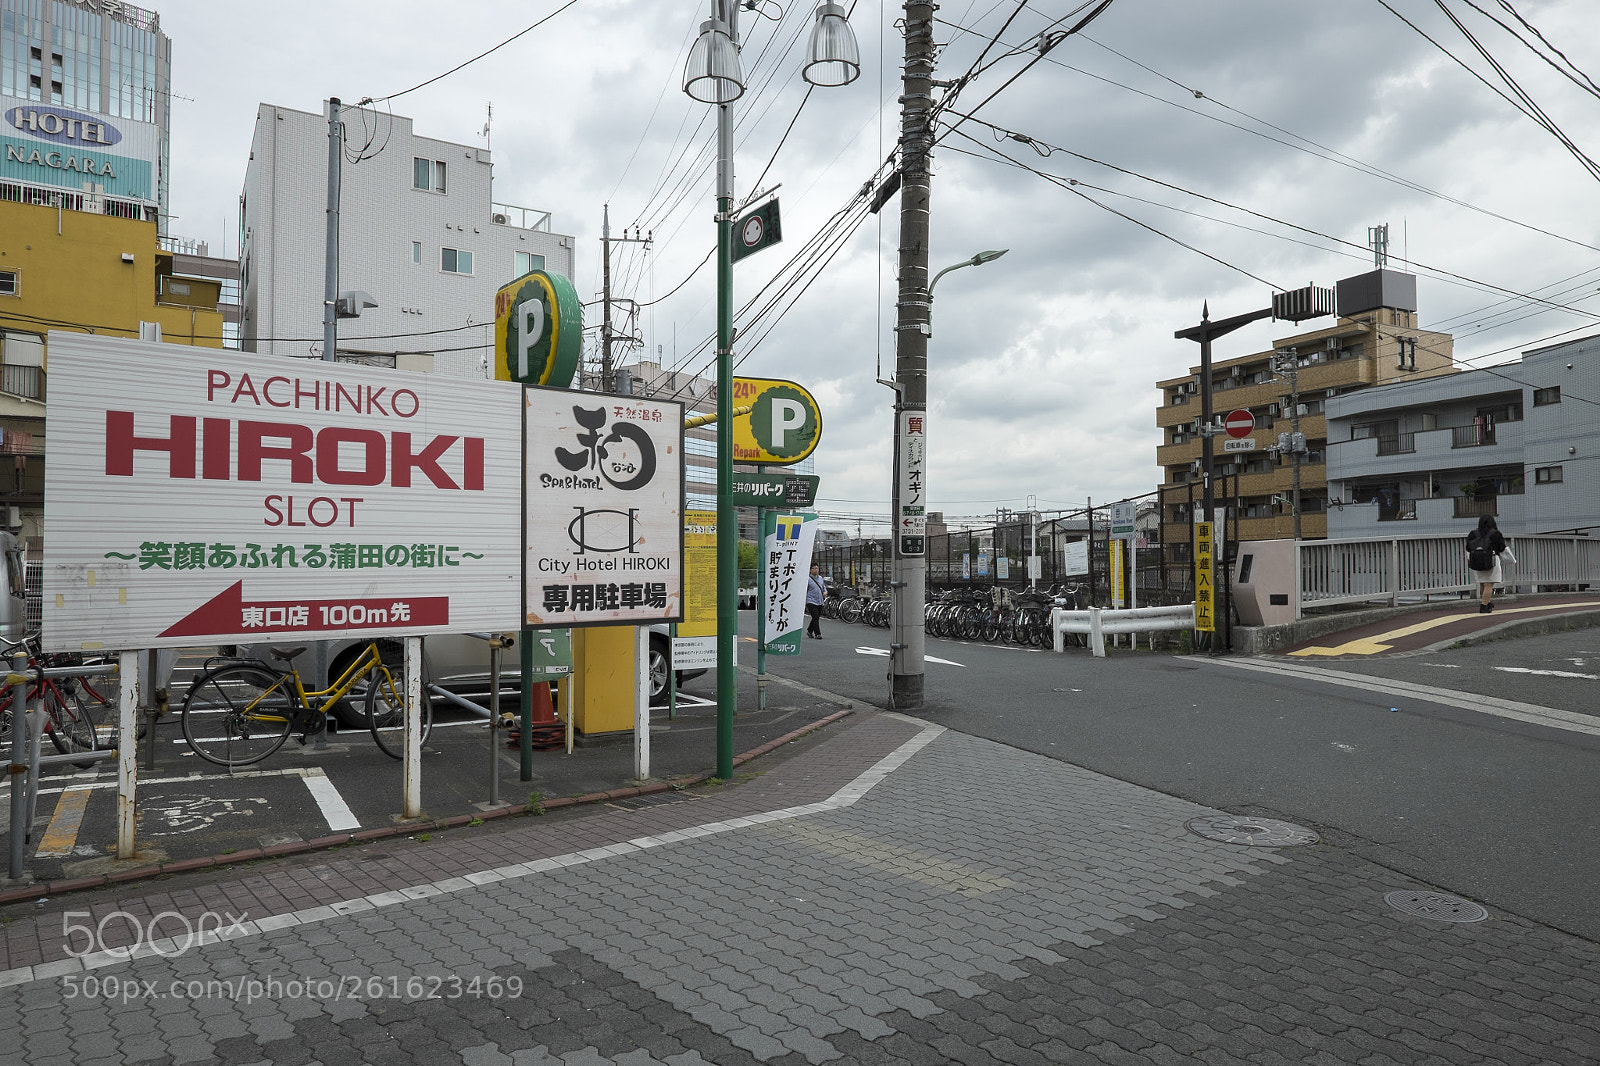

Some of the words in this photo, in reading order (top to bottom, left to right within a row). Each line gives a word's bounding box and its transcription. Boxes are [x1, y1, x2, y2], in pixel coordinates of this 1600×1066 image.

[14, 107, 113, 145] HOTEL
[5, 144, 117, 178] NAGARA
[518, 298, 545, 379] P
[207, 369, 420, 418] PACHINKO
[613, 406, 663, 423] 天然温泉
[771, 397, 807, 449] P
[907, 417, 923, 435] 質
[105, 410, 485, 491] HIROKI
[733, 444, 761, 460] Repark
[908, 469, 922, 505] オギノ
[264, 494, 364, 528] SLOT
[538, 557, 571, 574] City
[576, 557, 617, 571] Hotel
[623, 557, 670, 570] HIROKI
[1199, 525, 1210, 618] 車両進入禁止
[542, 582, 668, 613] 専用駐車場
[241, 605, 309, 628] 東口店
[319, 602, 411, 625] 100m先
